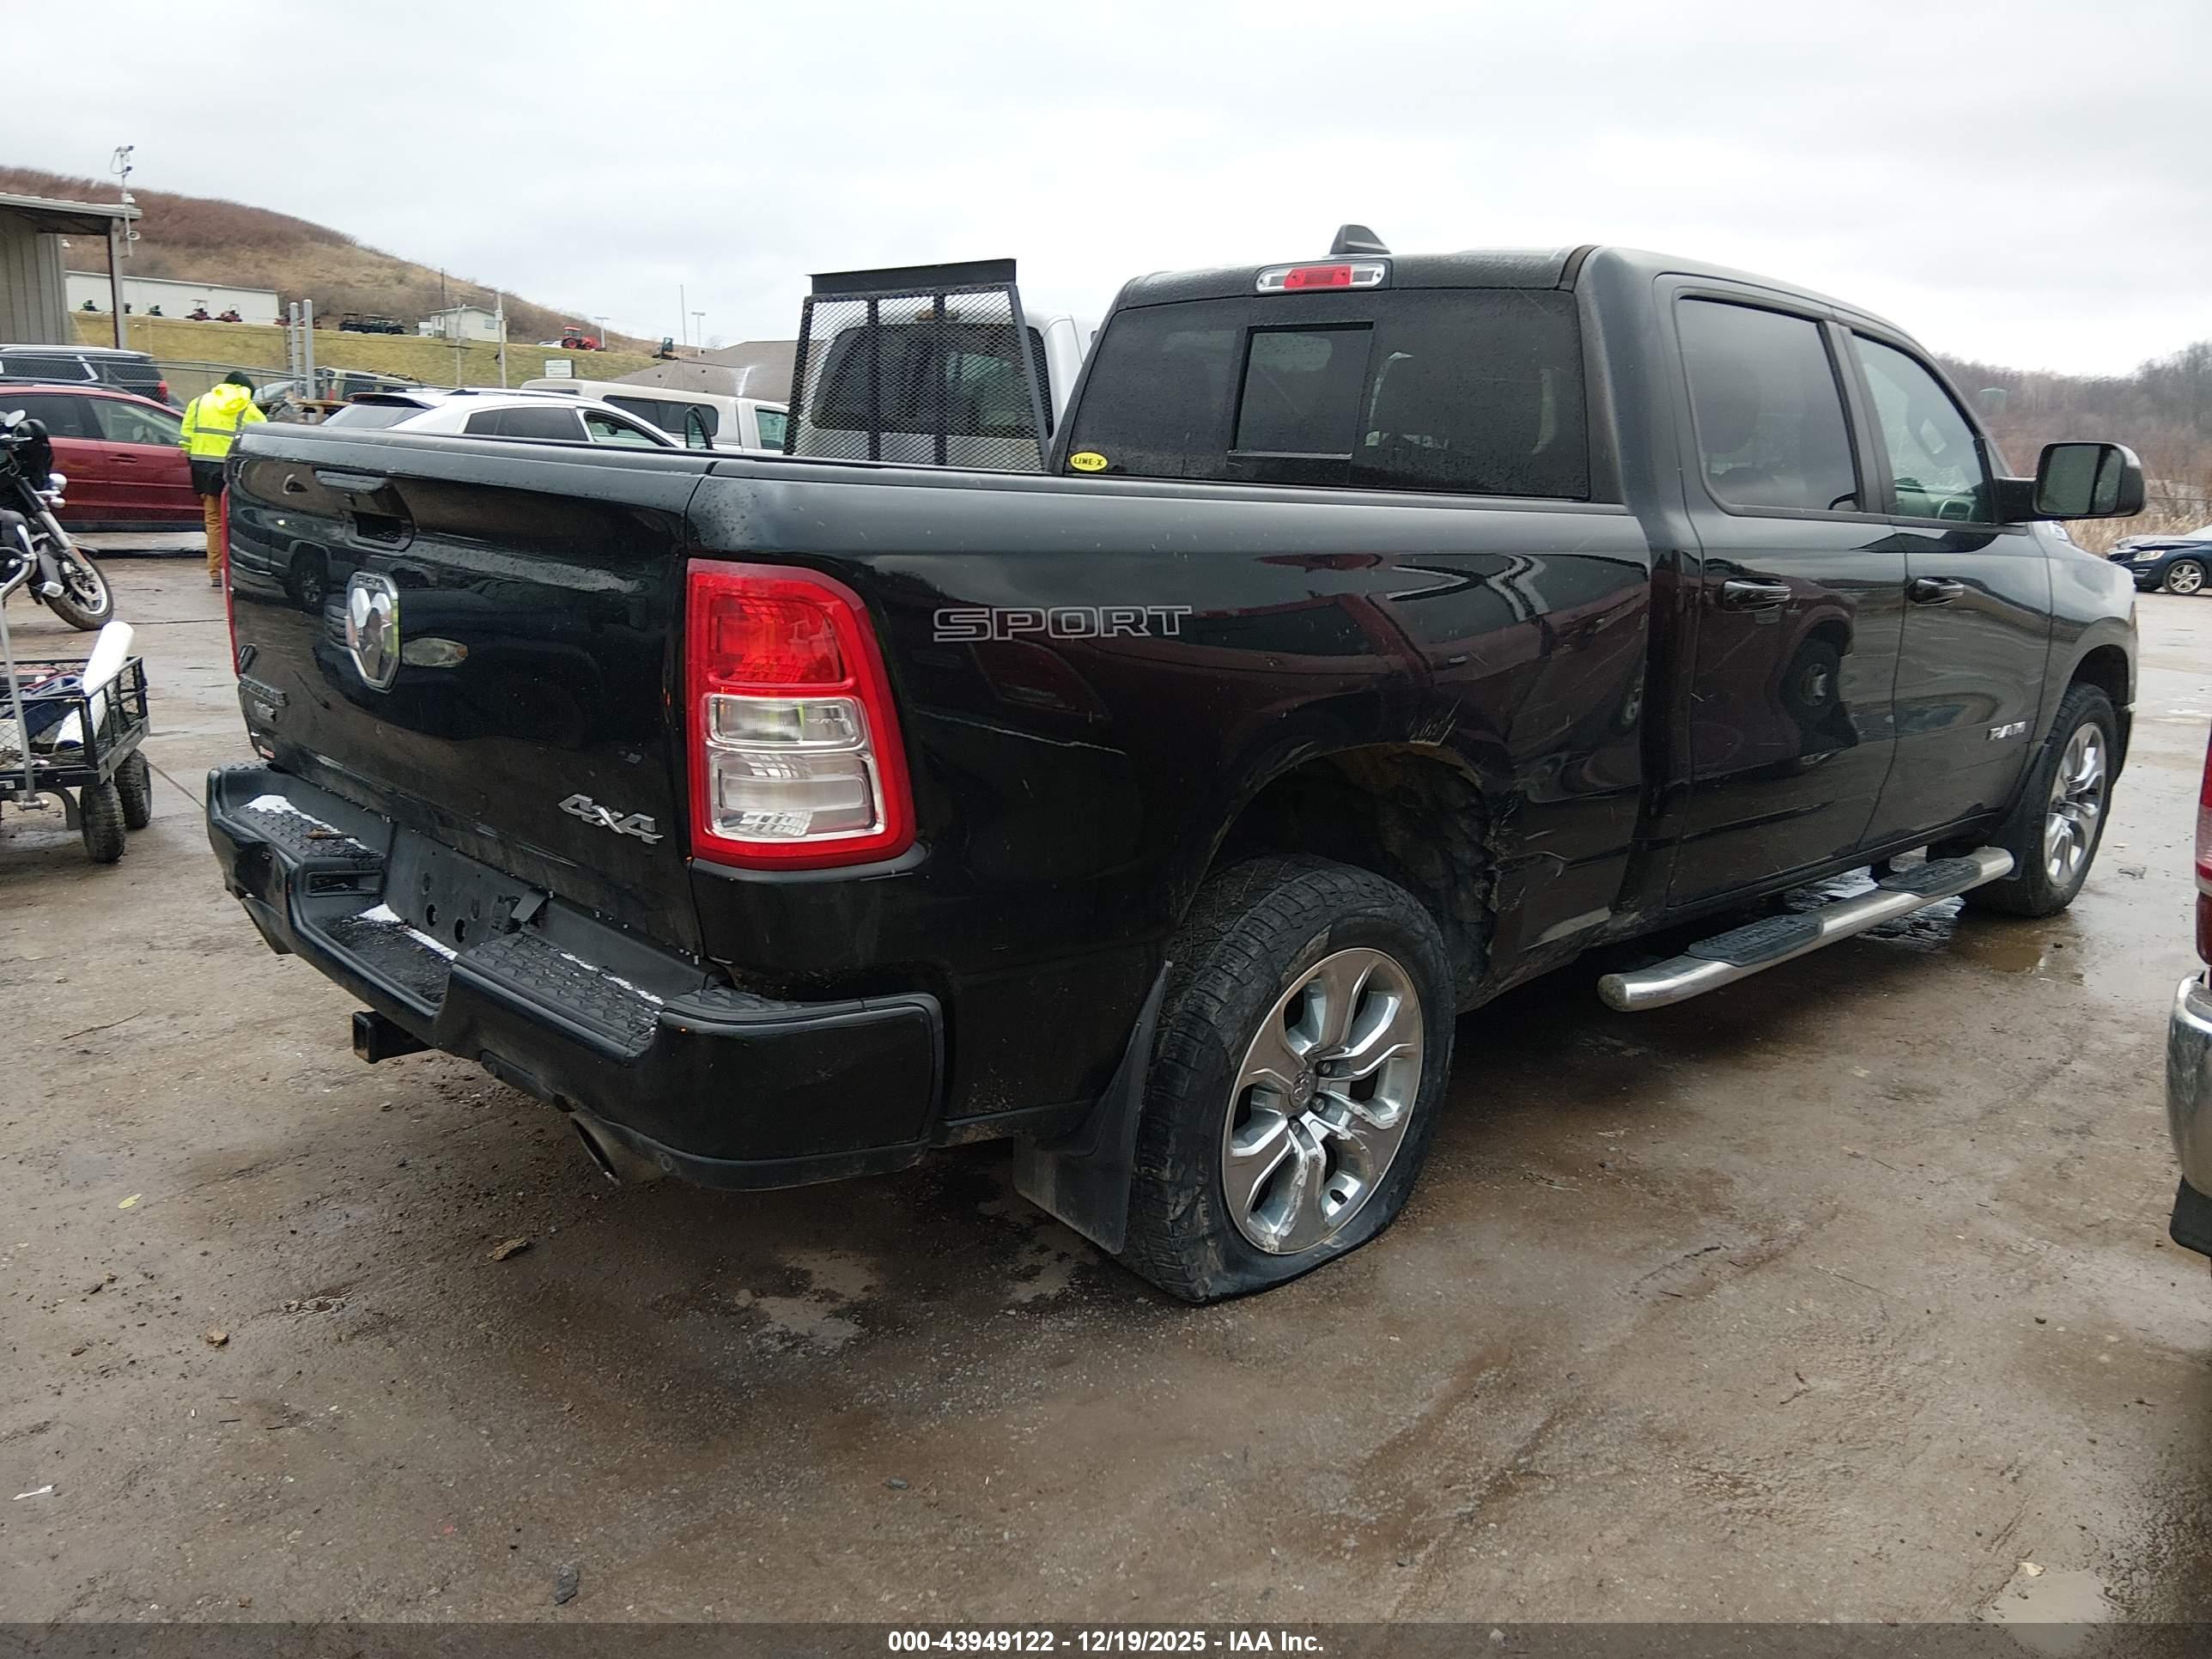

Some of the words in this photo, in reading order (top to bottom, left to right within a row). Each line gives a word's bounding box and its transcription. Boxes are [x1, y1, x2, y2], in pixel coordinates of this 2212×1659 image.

[1073, 457, 1104, 466] LINE-X
[933, 605, 1193, 642] SPORT
[1985, 720, 2027, 741] RAM
